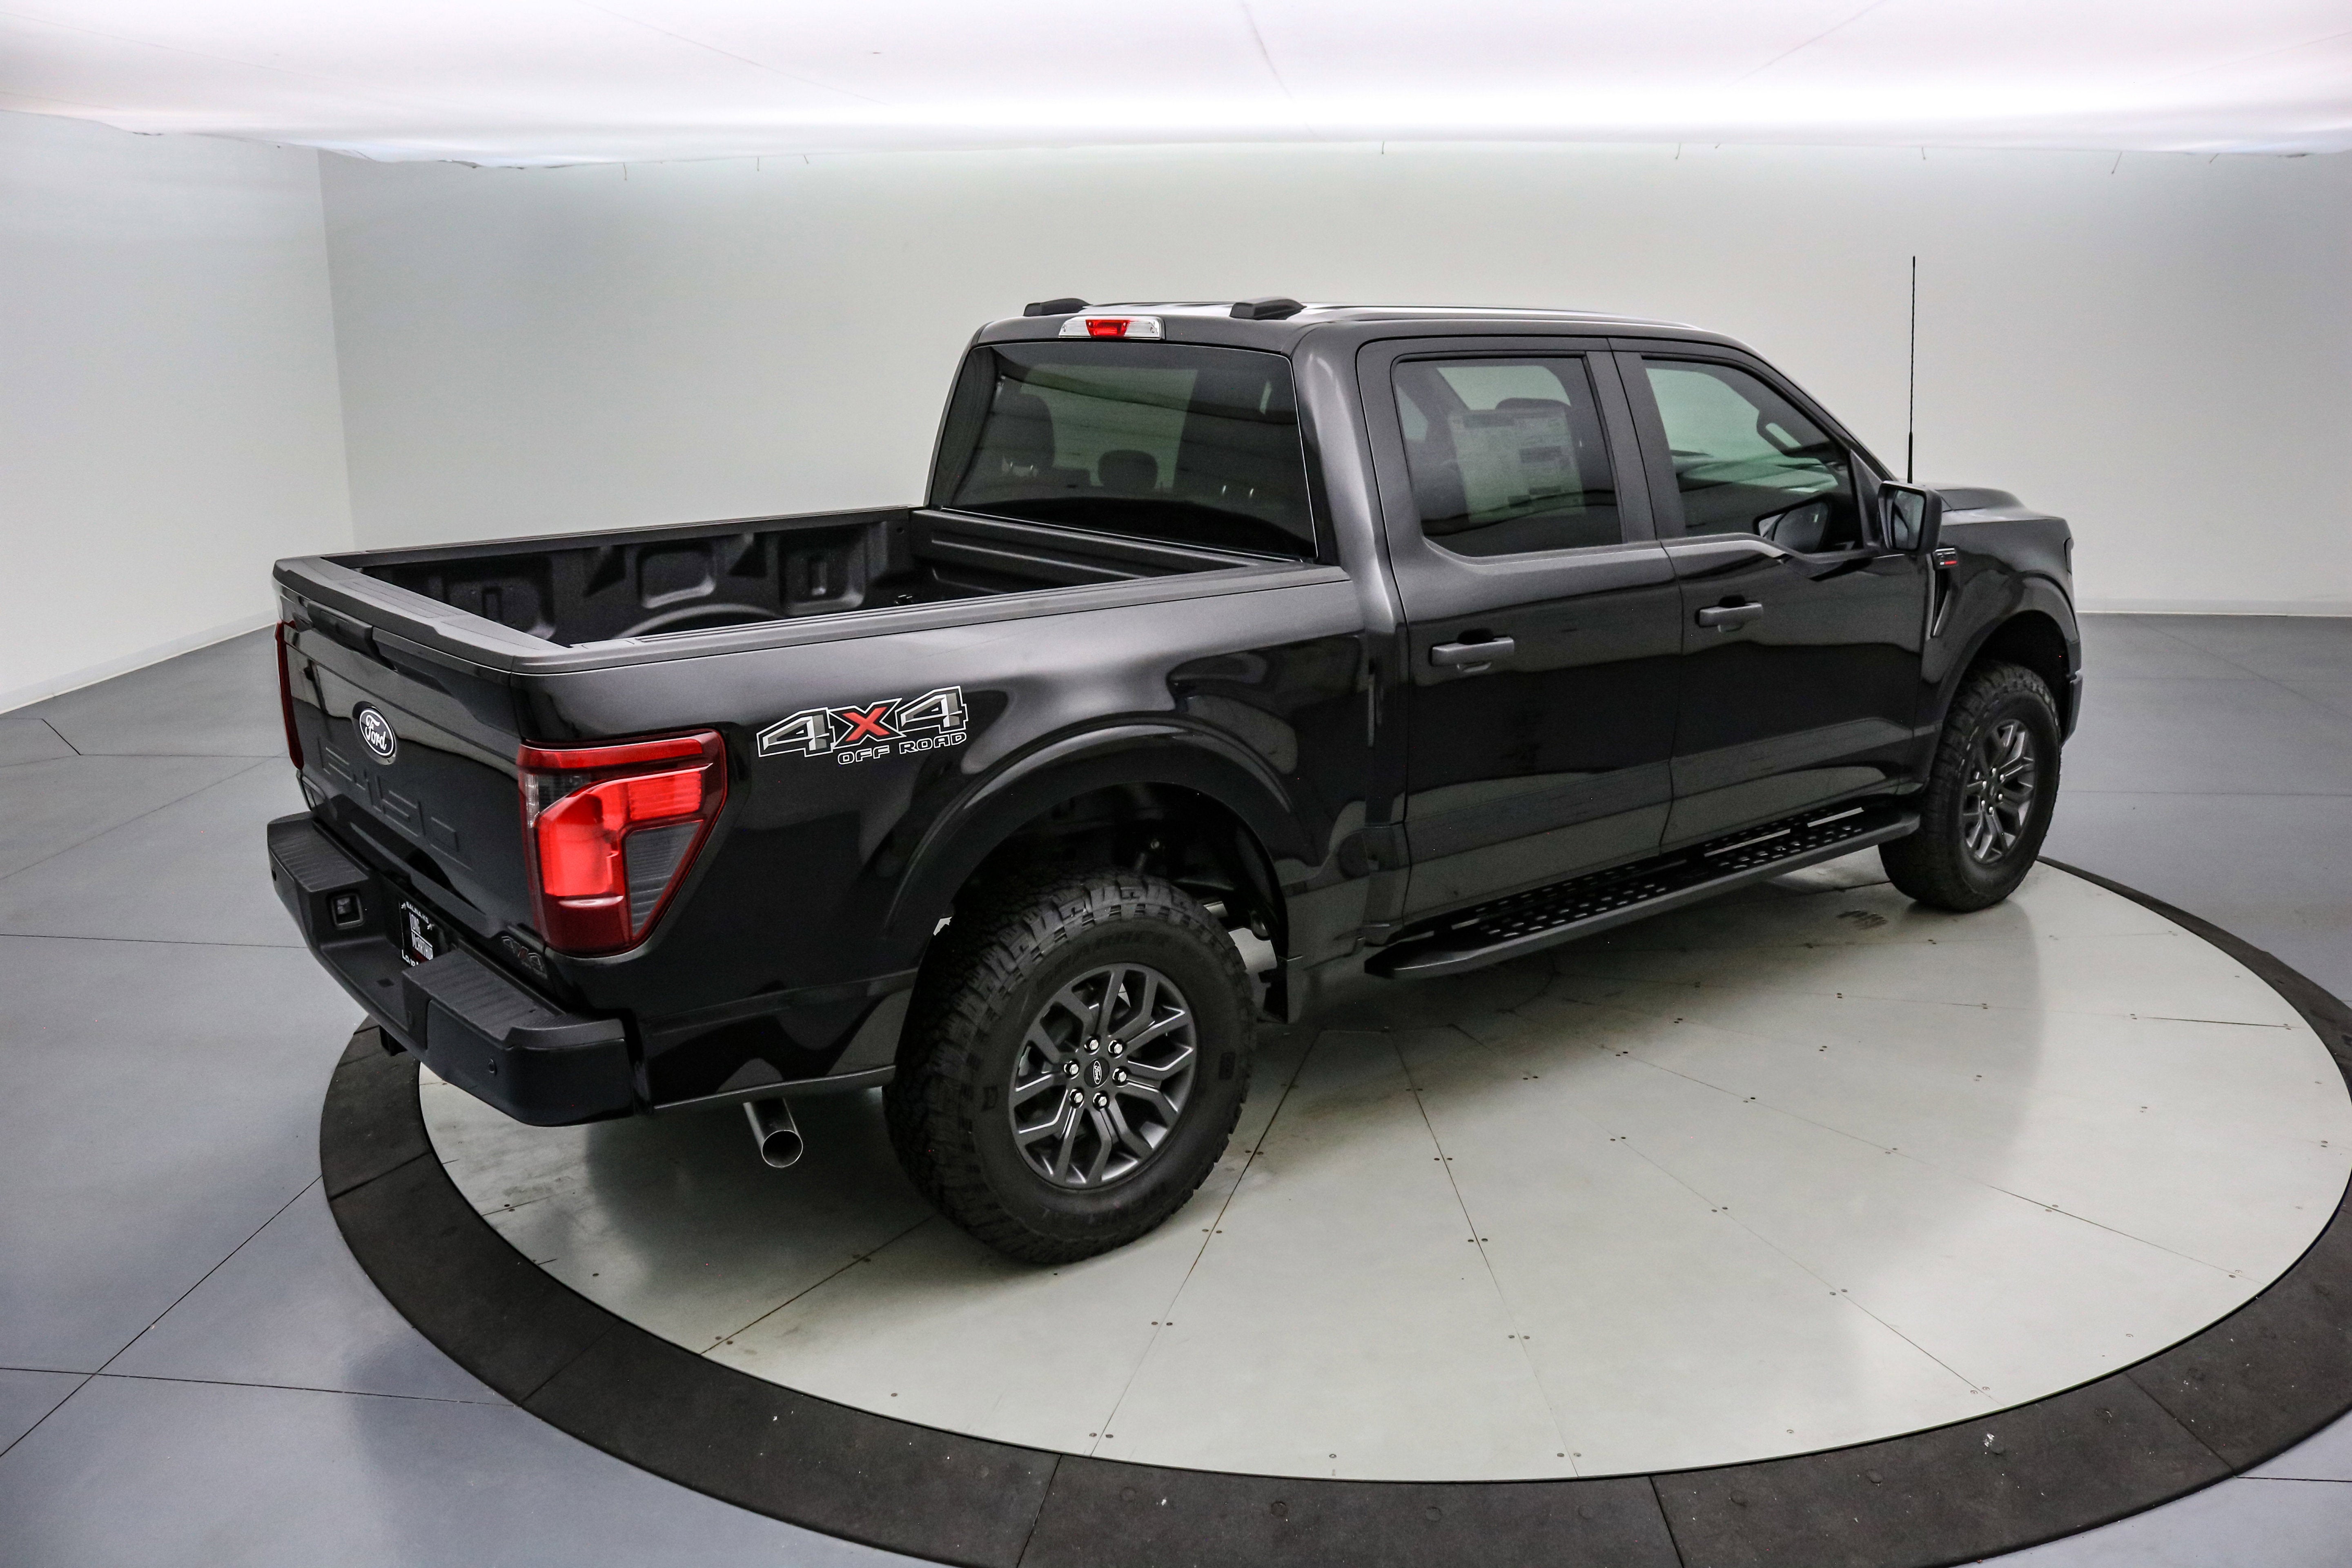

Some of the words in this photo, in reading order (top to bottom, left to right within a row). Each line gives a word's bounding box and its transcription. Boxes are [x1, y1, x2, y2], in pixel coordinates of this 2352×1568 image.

[365, 715, 387, 751] Ford
[757, 686, 968, 757] 4X4
[838, 745, 890, 765] OFF
[899, 732, 967, 755] ROAD
